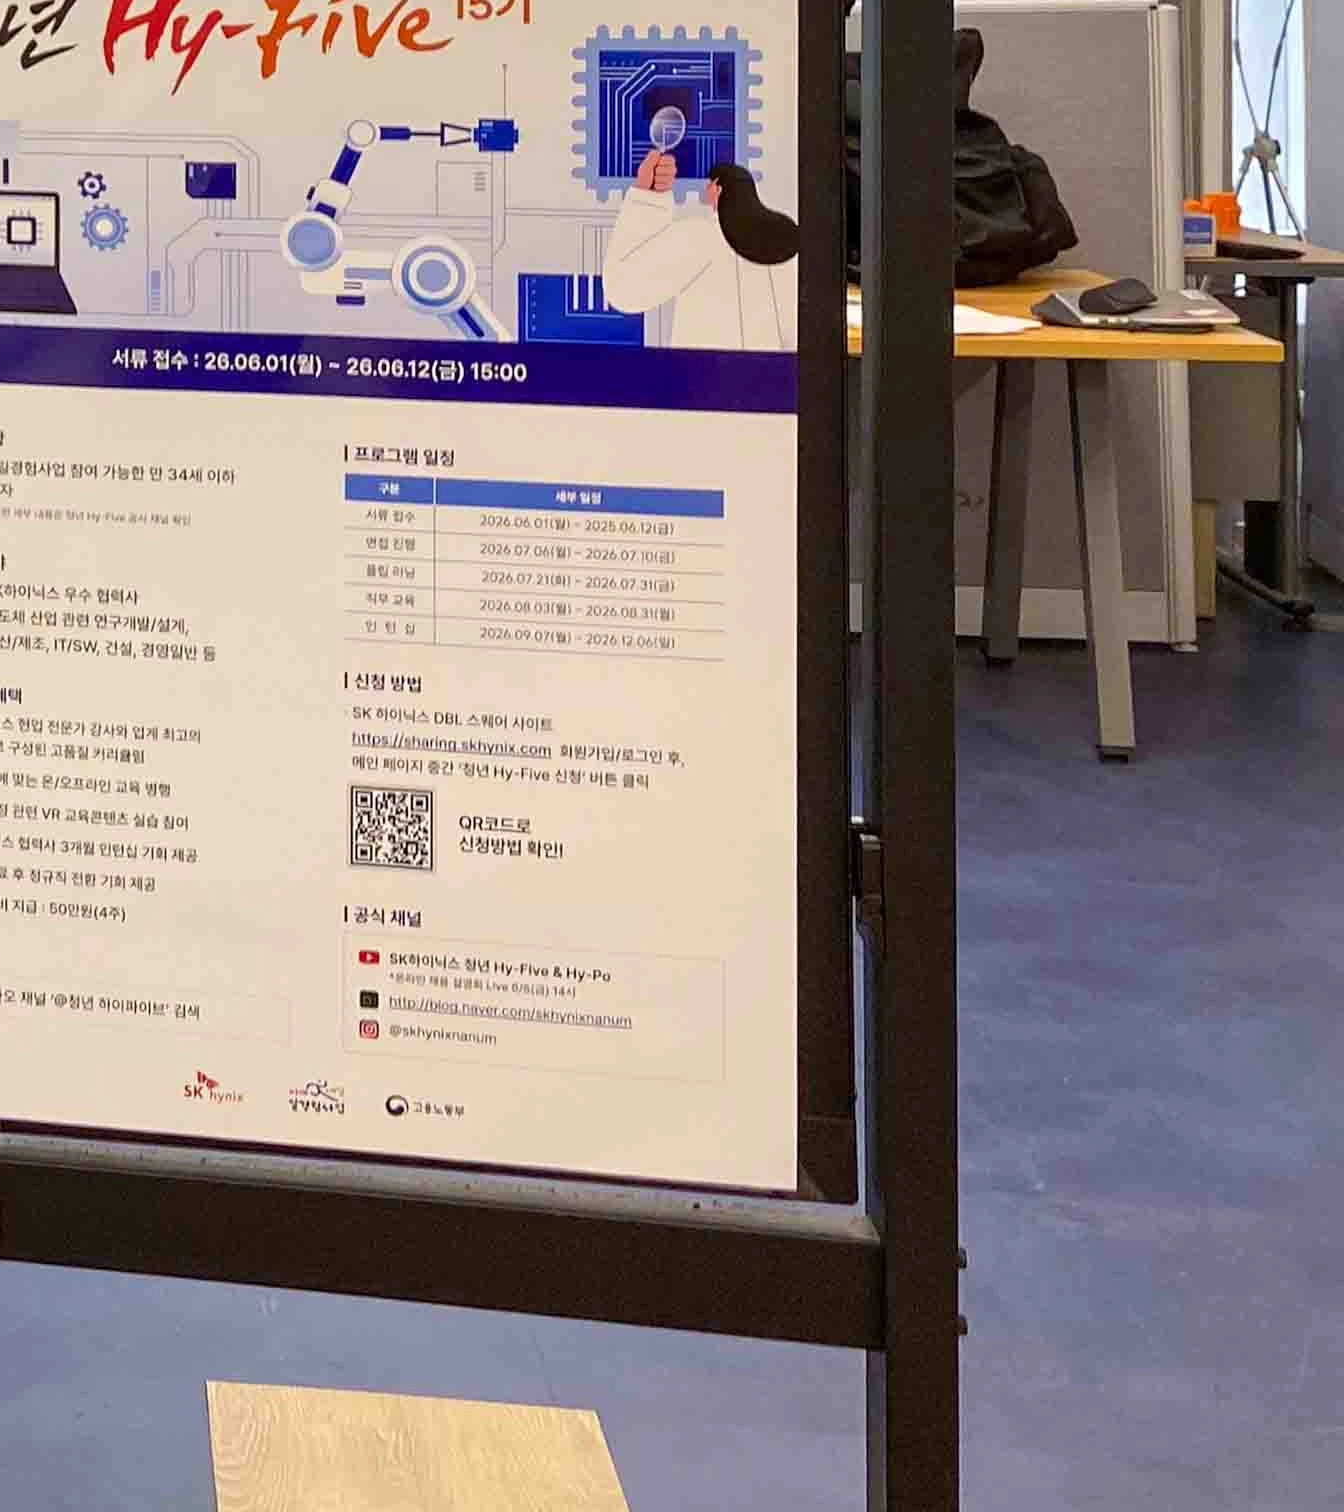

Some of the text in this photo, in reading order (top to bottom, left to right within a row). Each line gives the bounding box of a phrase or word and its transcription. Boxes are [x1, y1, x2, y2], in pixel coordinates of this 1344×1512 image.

[112, 348, 527, 383] 서류 접수 26.06.01(월) 26.06.12(금) 15:00
[355, 447, 454, 466] 프로그램 일정
[355, 673, 421, 693] 신청 방법
[459, 816, 530, 834] QR코드로
[460, 836, 563, 858] 신청방법 확인!
[354, 907, 421, 928] 공식 채널
[389, 1025, 496, 1045] @skhynixnanum
